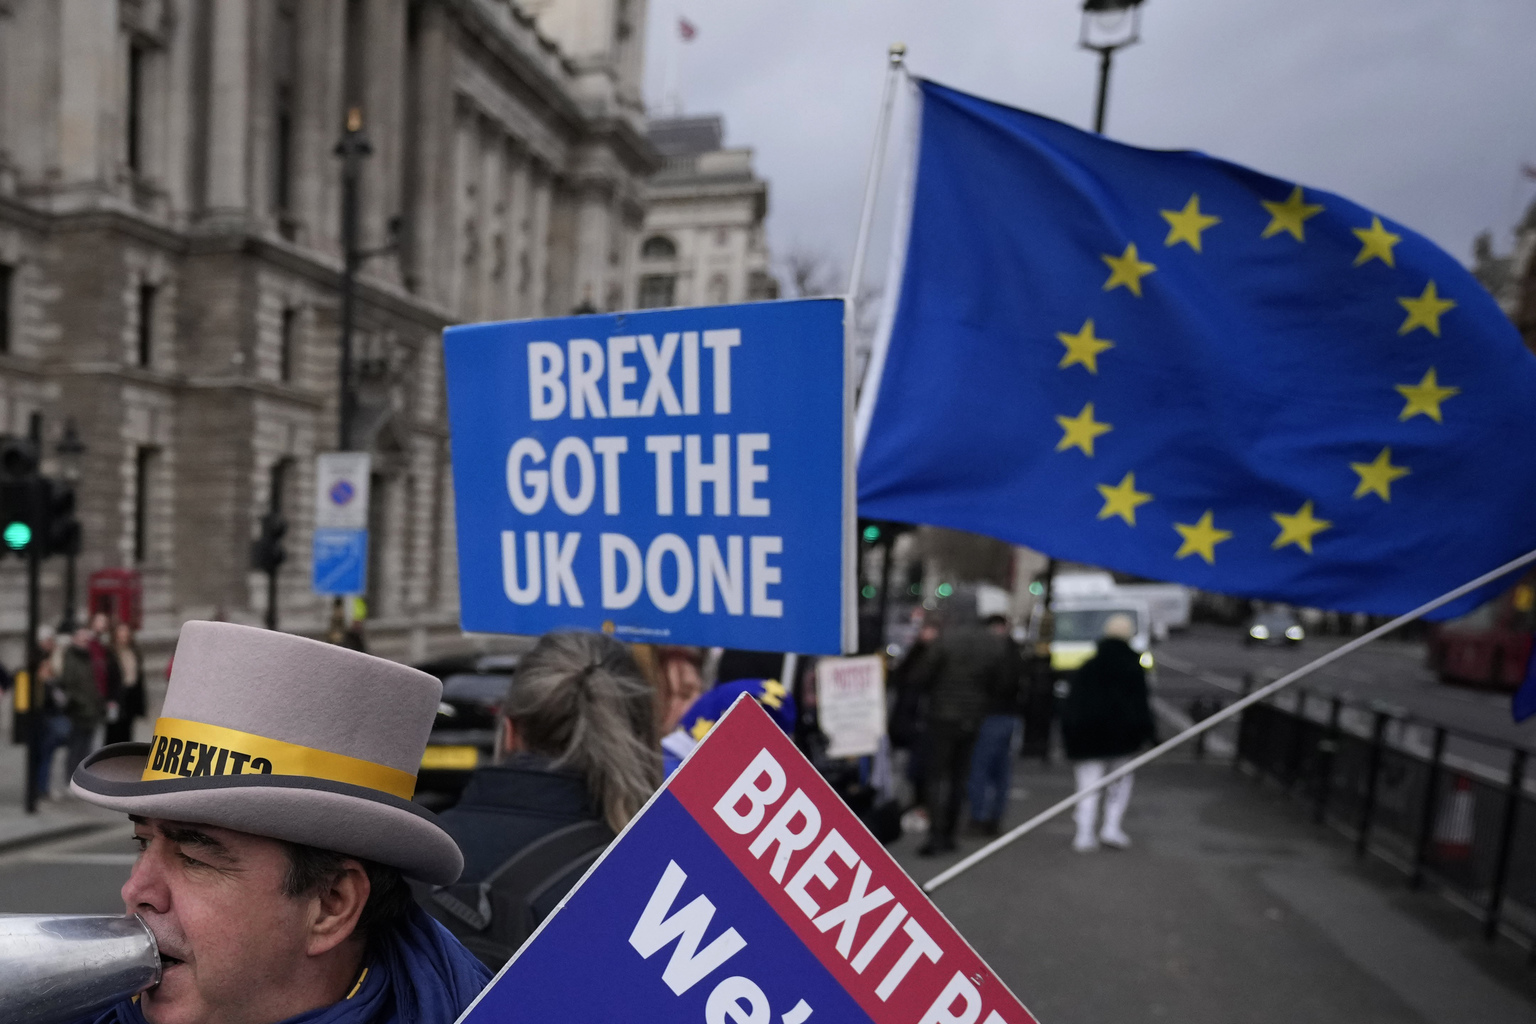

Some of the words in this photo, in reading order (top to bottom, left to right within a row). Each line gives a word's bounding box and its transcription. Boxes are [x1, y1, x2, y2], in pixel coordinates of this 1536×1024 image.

[527, 328, 742, 421] BREXIT
[506, 435, 628, 516] GOT
[645, 433, 771, 517] THE
[501, 530, 585, 607] UK
[600, 532, 783, 618] DONE
[152, 736, 273, 777] BREXIT?
[712, 747, 945, 1003] BREXIT
